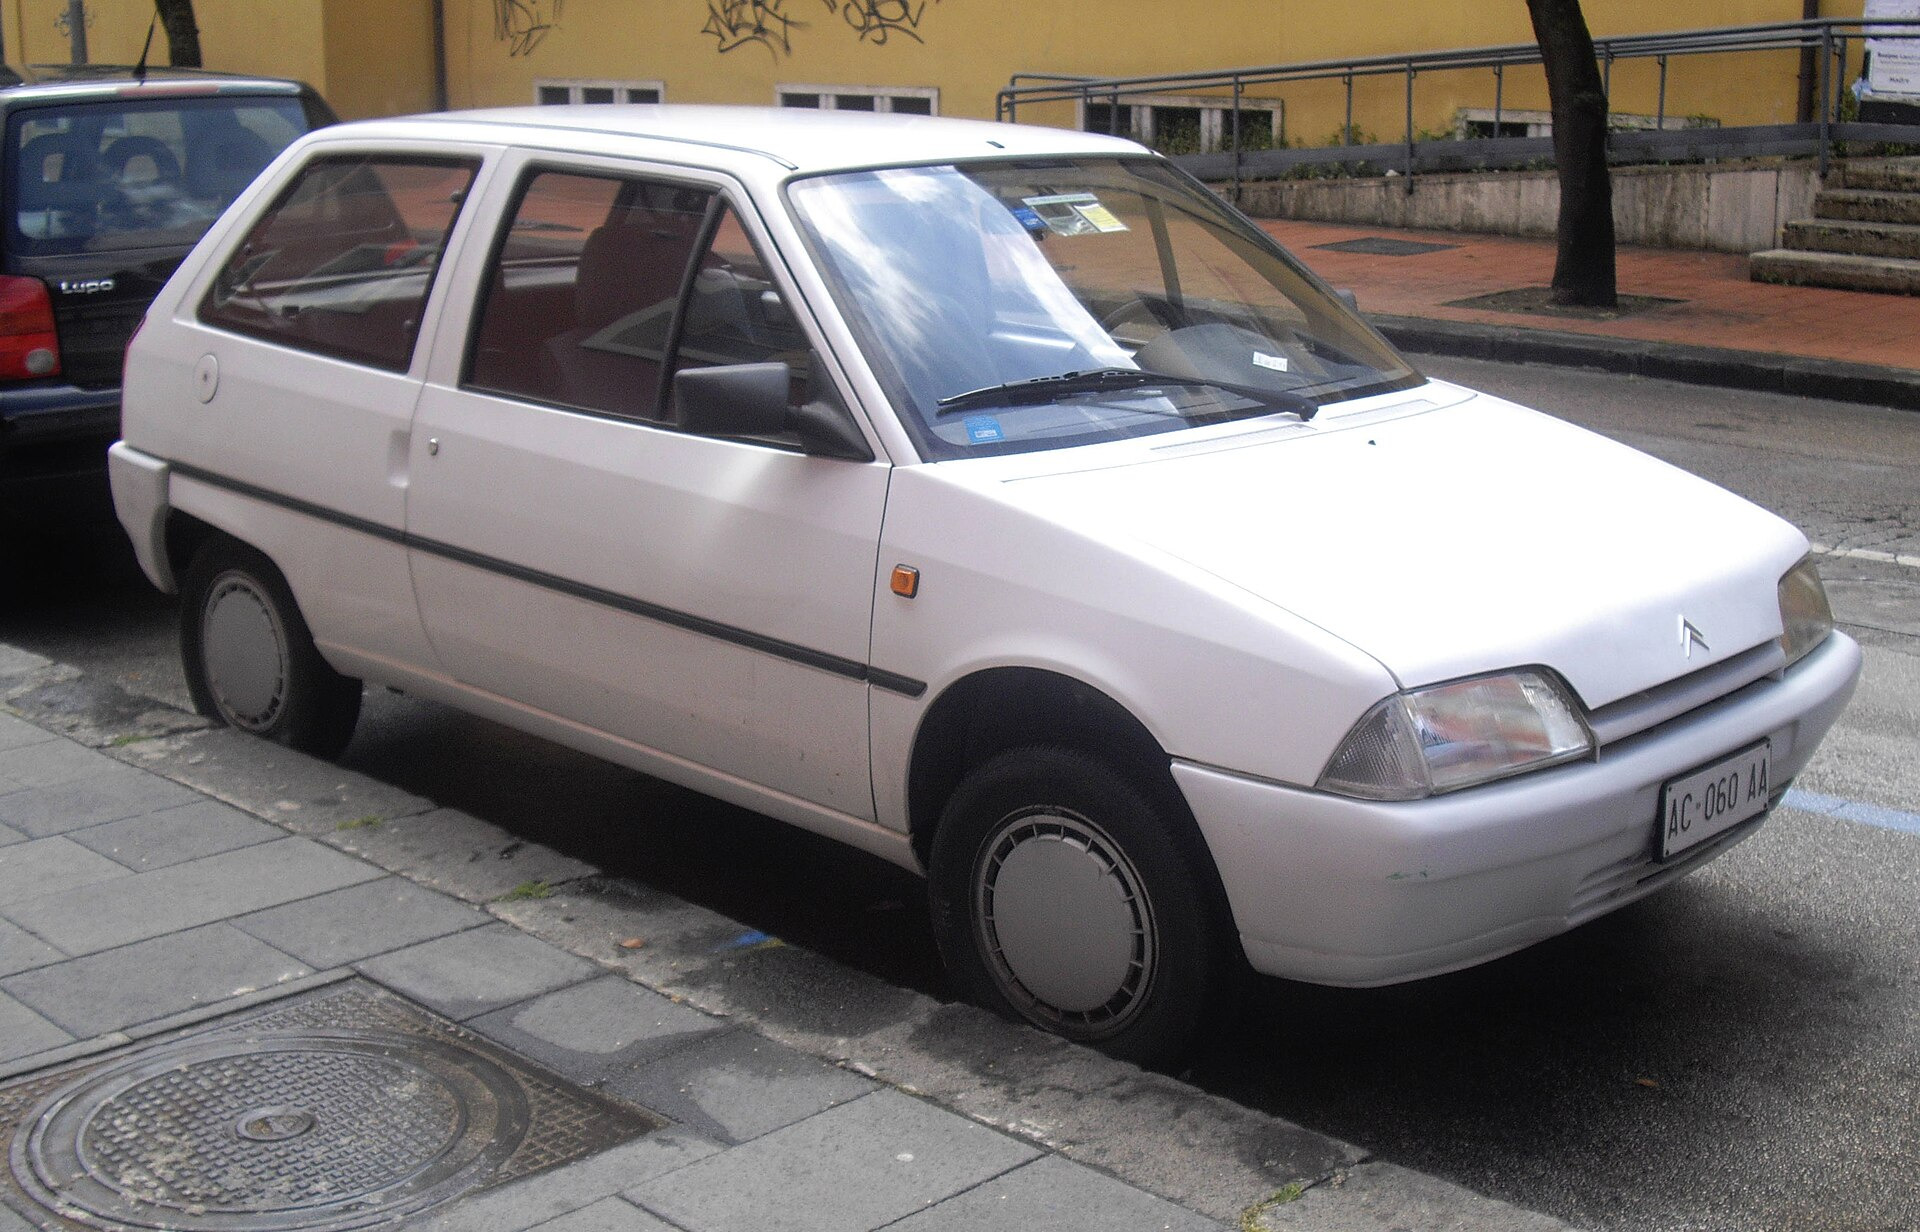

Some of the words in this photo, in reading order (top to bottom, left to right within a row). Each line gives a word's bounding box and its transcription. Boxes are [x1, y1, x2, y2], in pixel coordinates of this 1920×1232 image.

[1668, 794, 1692, 839] AC
[1704, 773, 1738, 820] 060
[1747, 759, 1767, 802] AA
